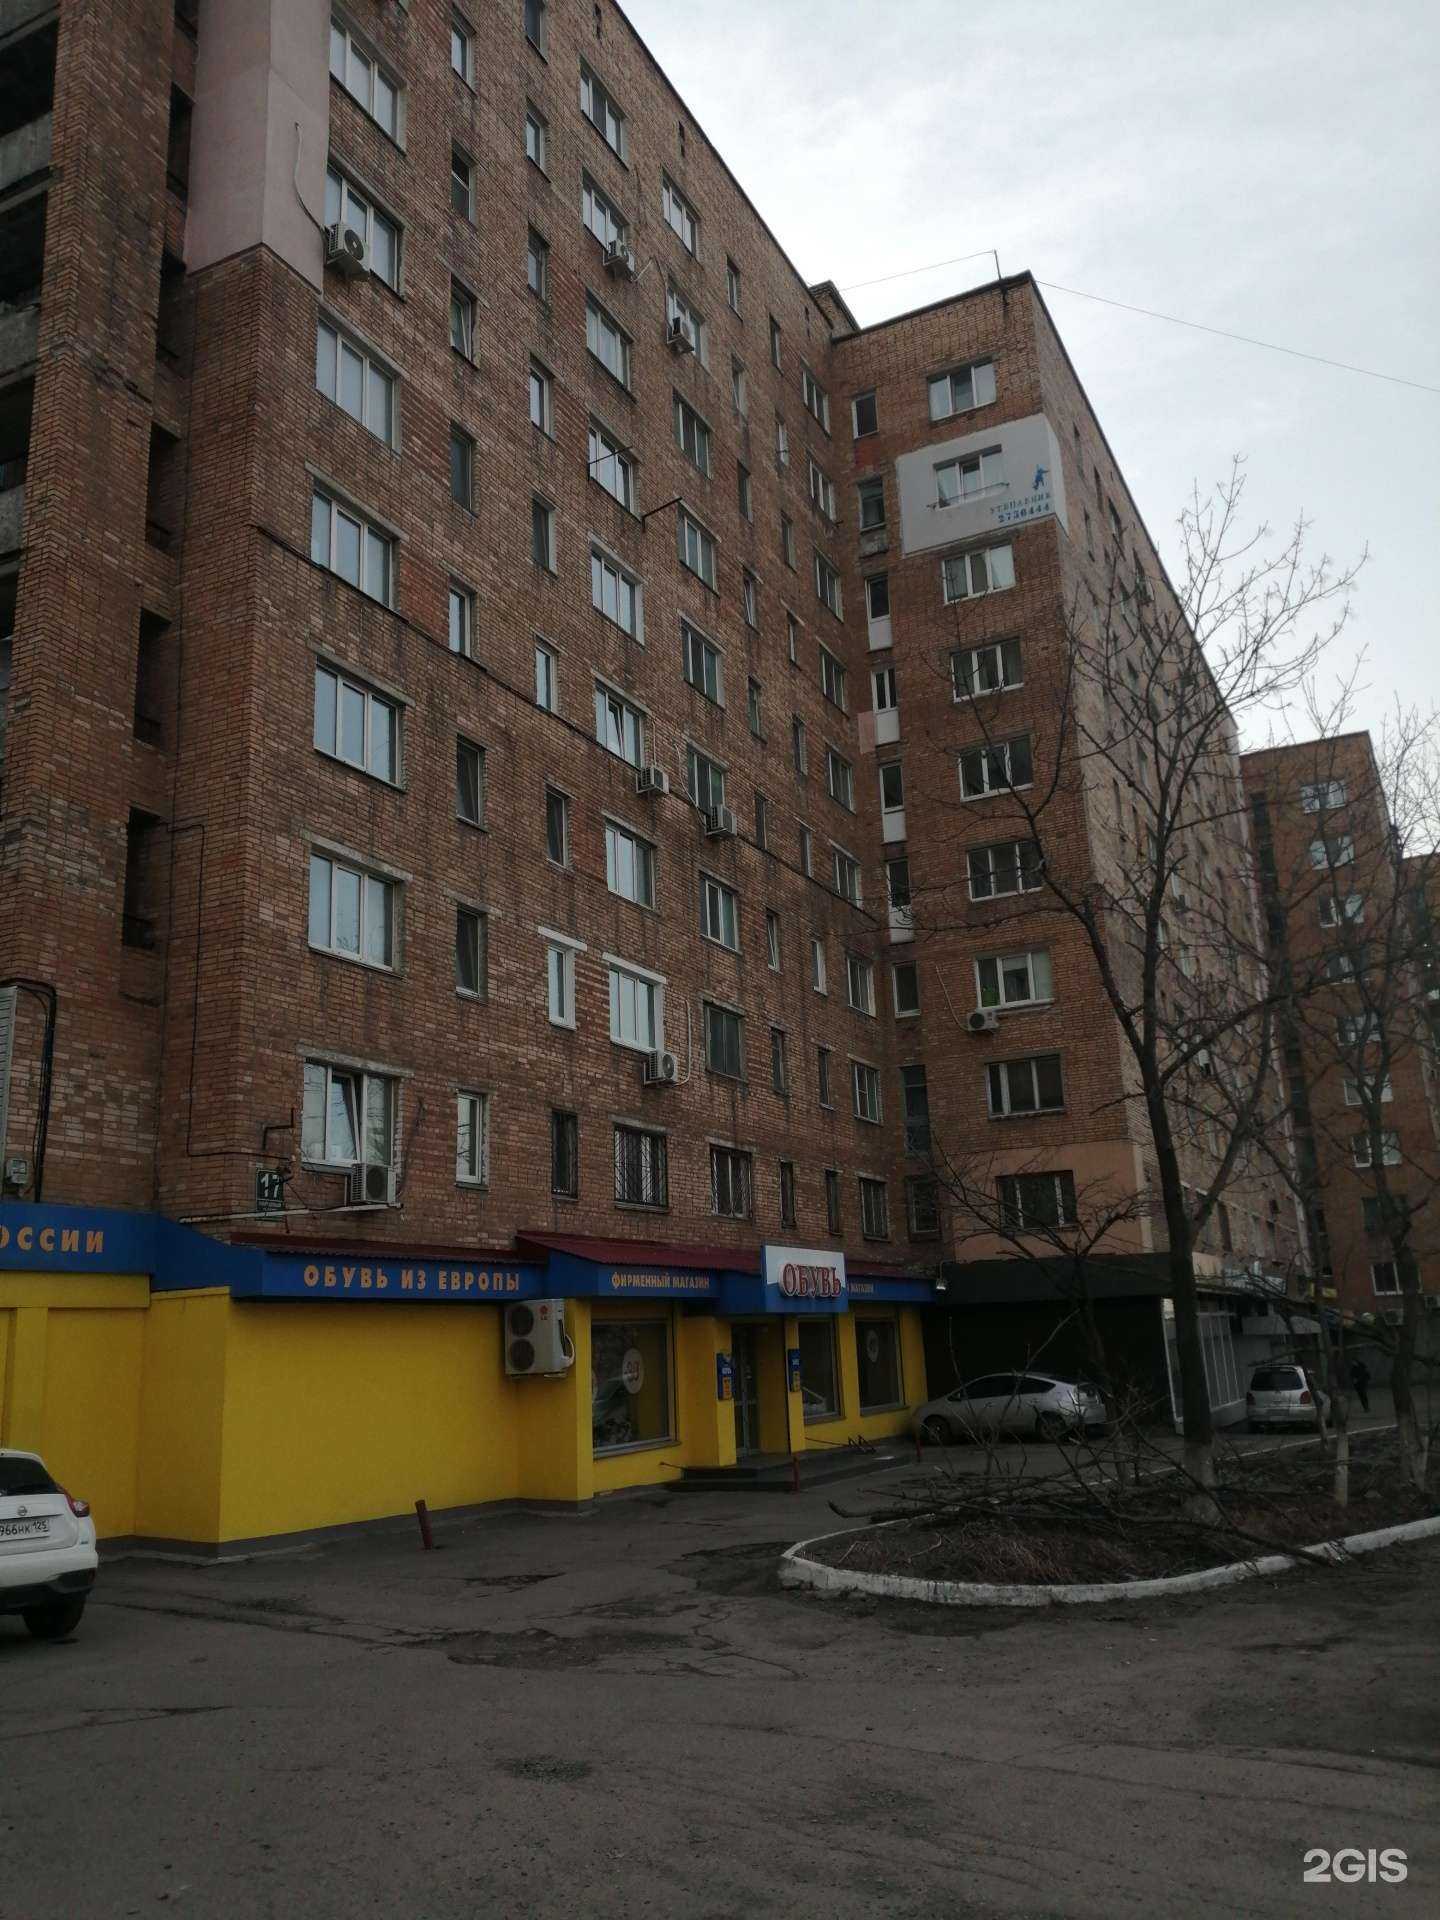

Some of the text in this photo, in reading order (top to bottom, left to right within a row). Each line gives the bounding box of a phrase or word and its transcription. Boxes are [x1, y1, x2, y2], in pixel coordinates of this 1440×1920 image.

[261, 1173, 280, 1198] 17
[303, 1264, 520, 1291] ОБУВЬ ИЗ ЕВРОПЫ
[611, 1272, 710, 1289] ФИРМЕННЫЙ МАГАЗИН
[782, 1262, 842, 1298] ОБУВЬ
[33, 1520, 47, 1530] 125
